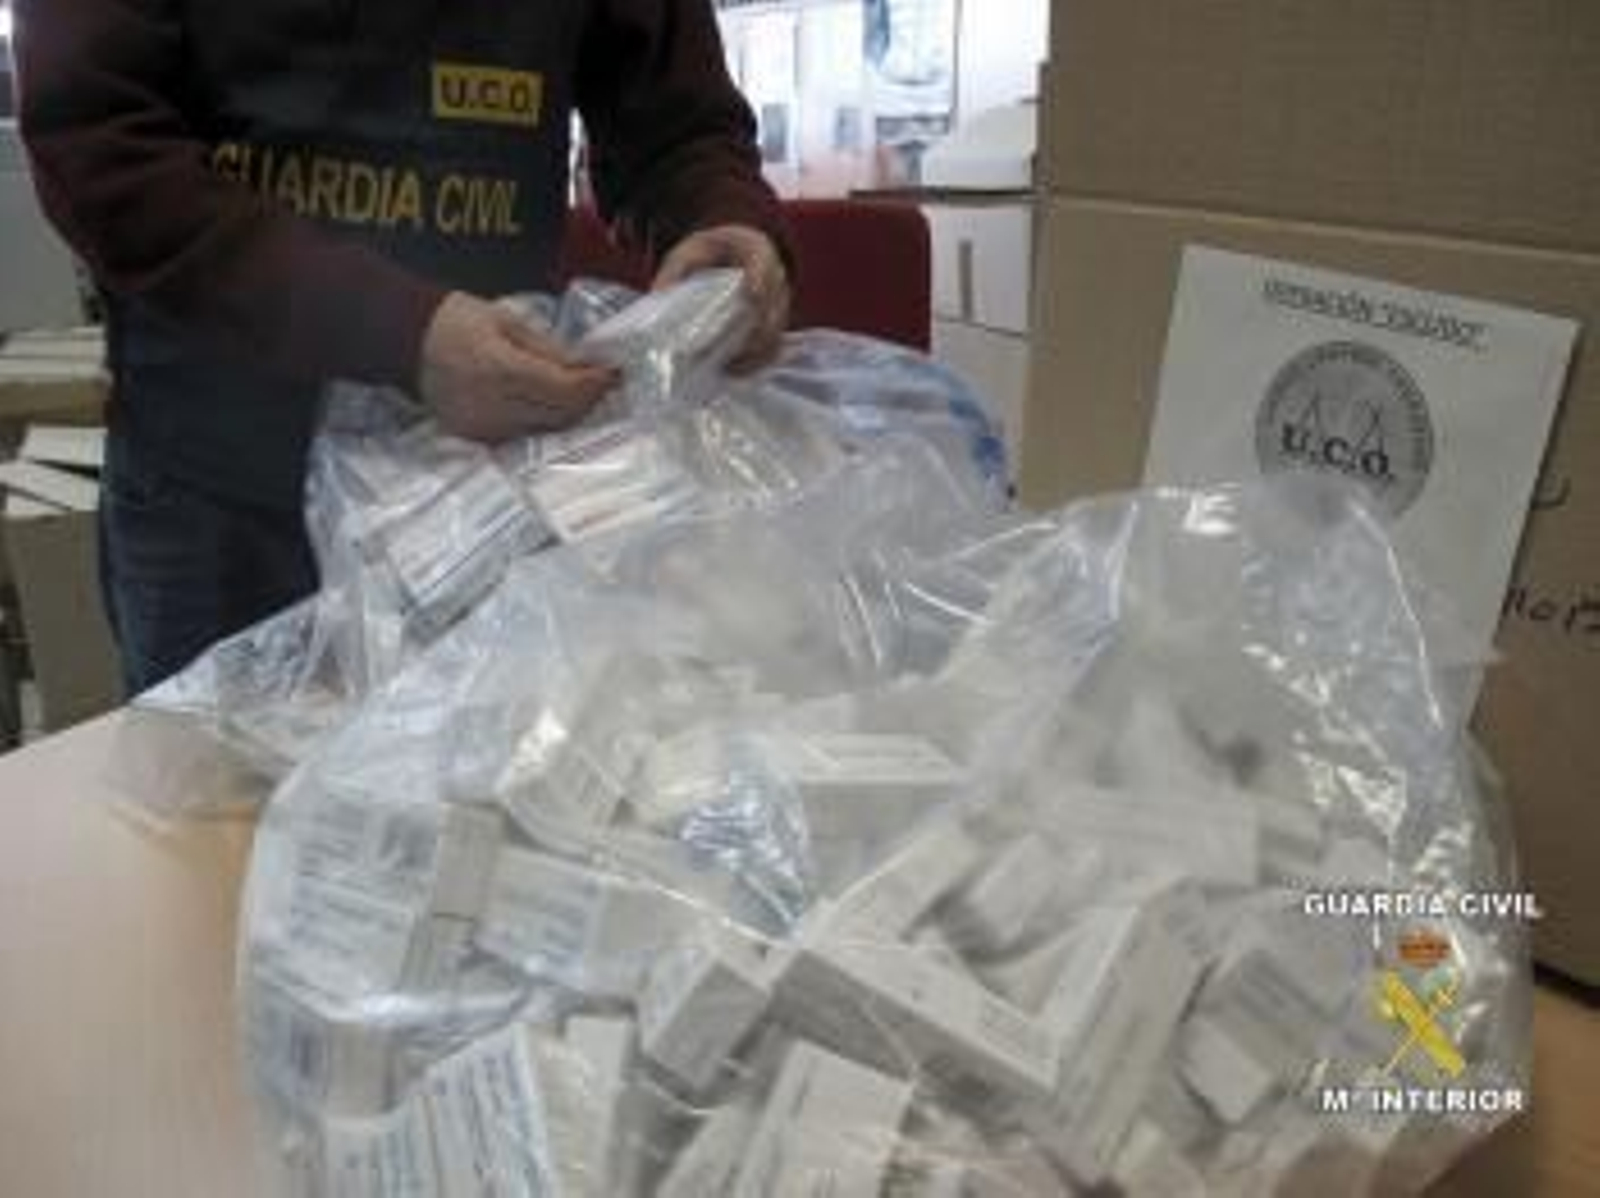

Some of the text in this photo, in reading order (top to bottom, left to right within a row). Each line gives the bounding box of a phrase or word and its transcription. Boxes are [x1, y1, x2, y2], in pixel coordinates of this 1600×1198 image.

[212, 142, 523, 236] GUARDIA CIVIL
[1281, 423, 1397, 485] U.C.O.
